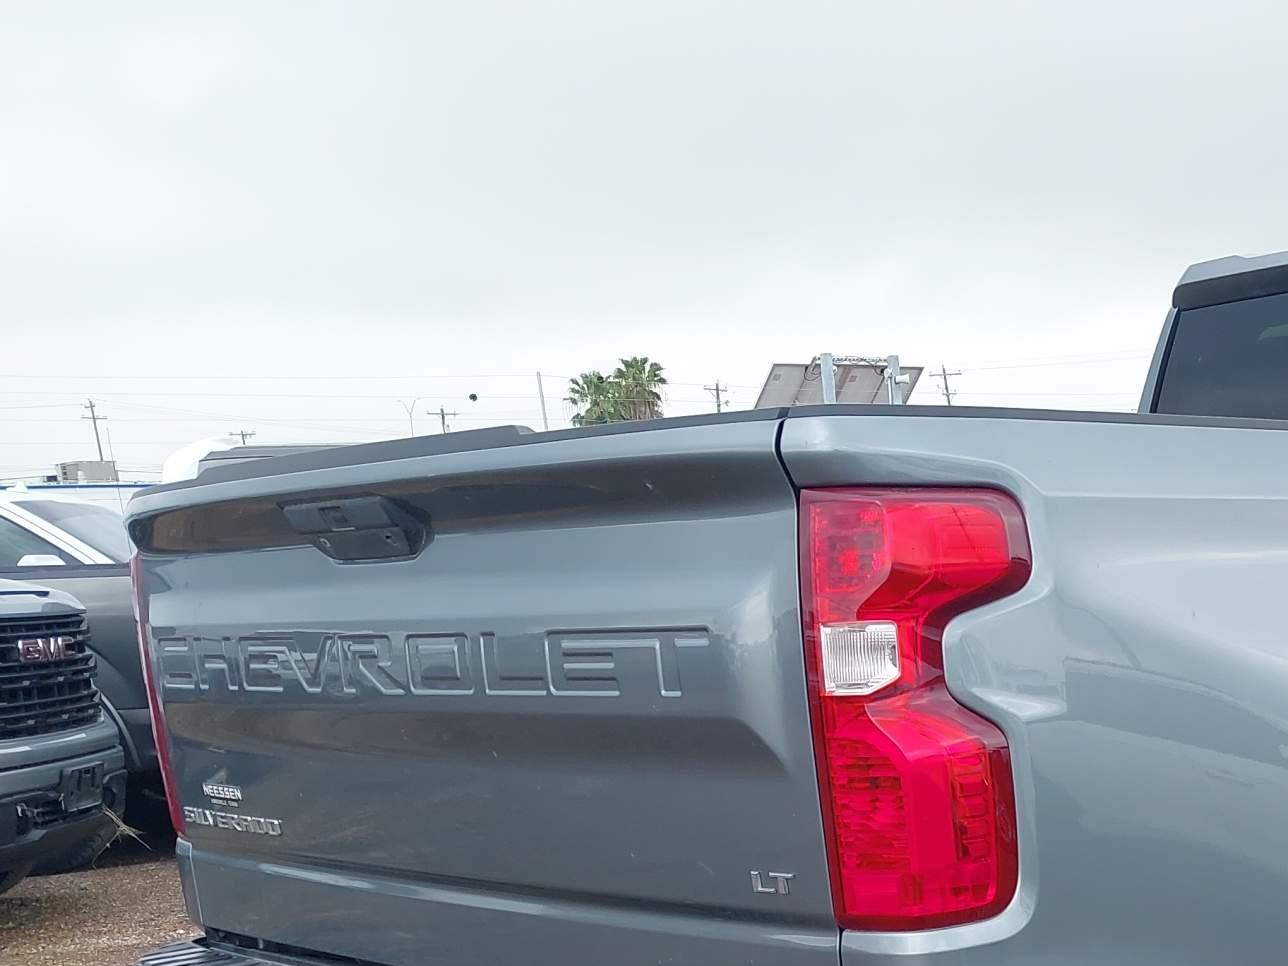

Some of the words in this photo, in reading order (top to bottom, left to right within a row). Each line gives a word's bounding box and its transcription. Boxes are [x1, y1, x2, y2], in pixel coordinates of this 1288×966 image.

[17, 635, 75, 662] GMC
[157, 624, 712, 696] CHEVROLET
[202, 783, 243, 800] NEESSEN
[183, 806, 283, 836] SILVERADO
[750, 870, 794, 895] LT
